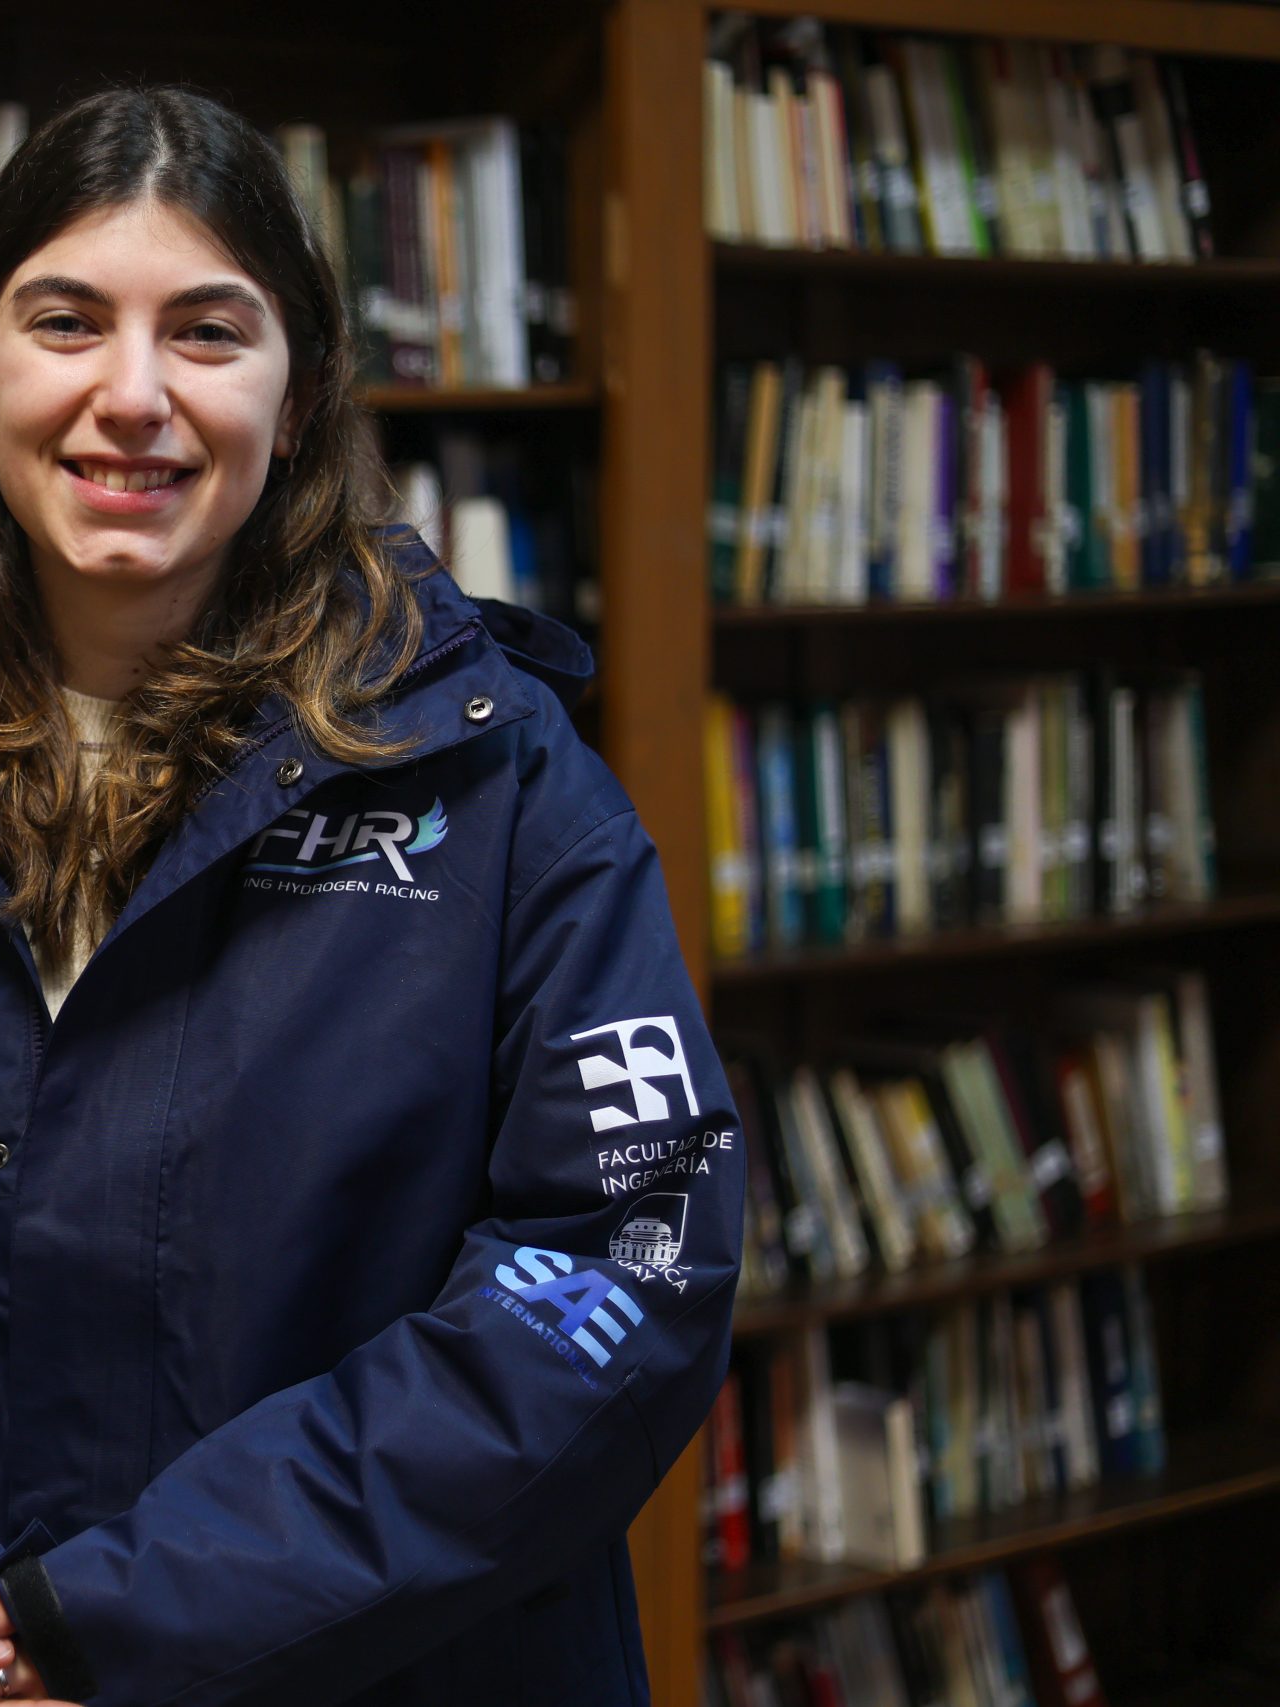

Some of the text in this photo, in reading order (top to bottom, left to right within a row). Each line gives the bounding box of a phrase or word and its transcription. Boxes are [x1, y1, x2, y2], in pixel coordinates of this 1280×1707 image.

[249, 809, 414, 882] FHR
[278, 880, 370, 895] HYDROGEN
[375, 883, 440, 901] RACING
[598, 1131, 734, 1170] FACULTAD DE
[495, 1246, 645, 1369] SAE
